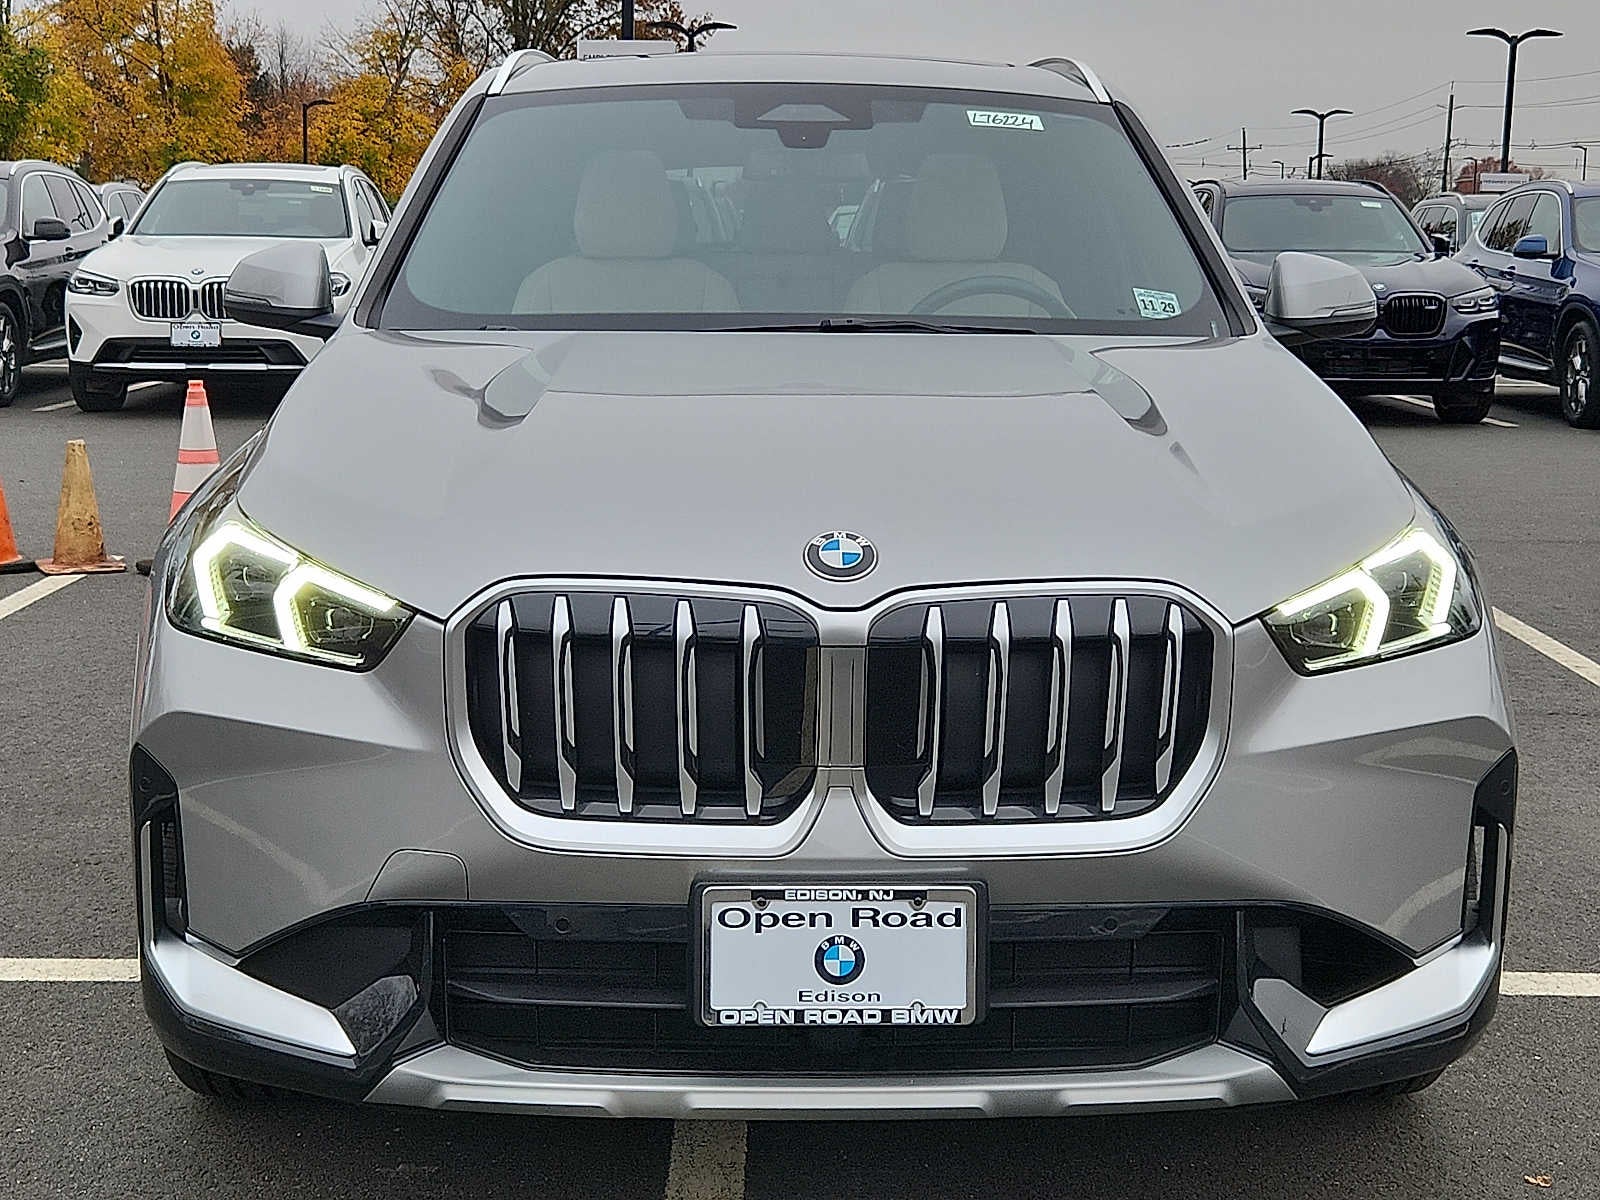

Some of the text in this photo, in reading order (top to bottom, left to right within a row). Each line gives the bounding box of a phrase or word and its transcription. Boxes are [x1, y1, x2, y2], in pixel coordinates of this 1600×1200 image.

[1160, 301, 1176, 314] 29
[811, 531, 870, 546] BMW
[784, 889, 894, 901] EDISON, NJ
[717, 907, 962, 933] Open Road
[820, 936, 860, 951] BMW
[798, 990, 881, 1003] Edison
[719, 1009, 959, 1024] OPEN ROAD BMW
